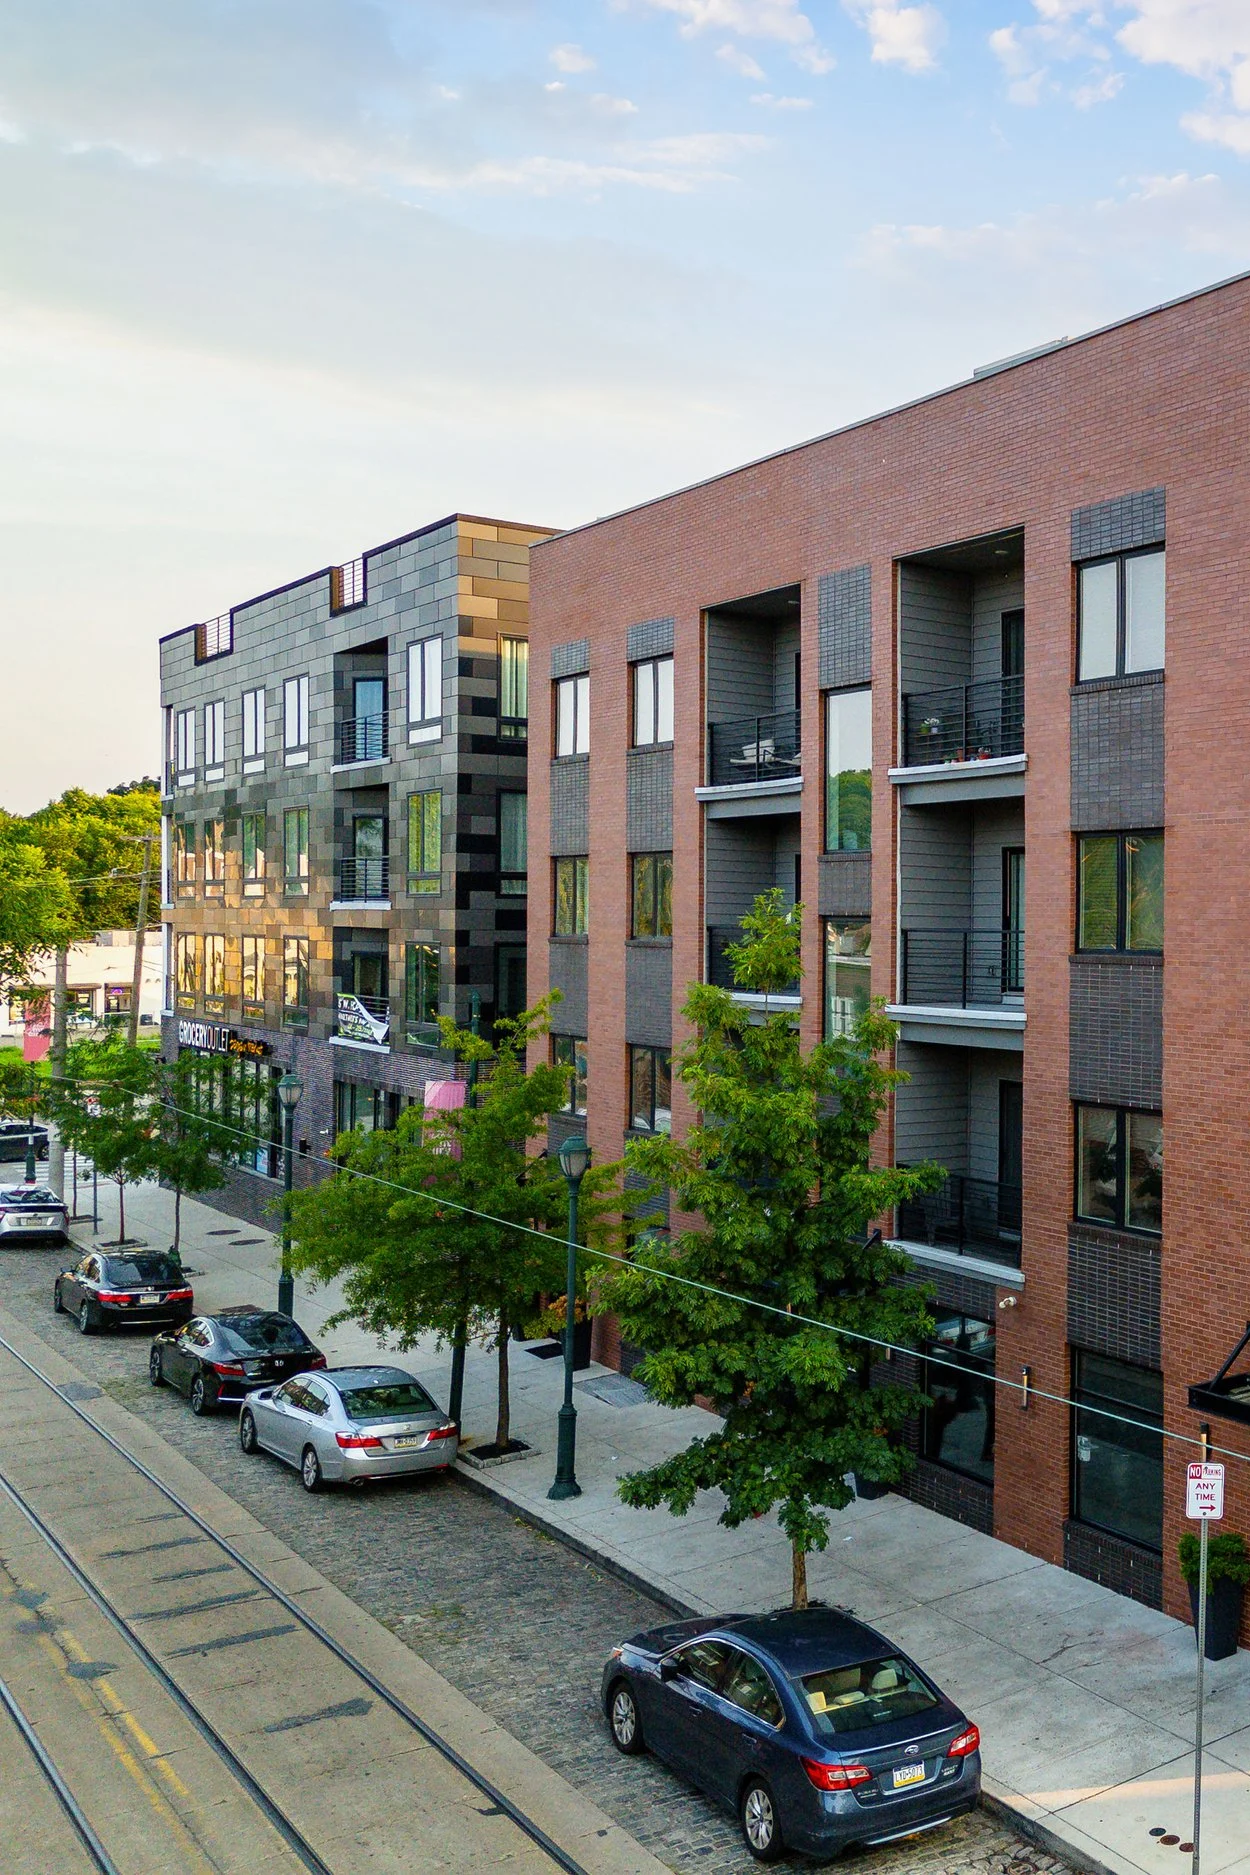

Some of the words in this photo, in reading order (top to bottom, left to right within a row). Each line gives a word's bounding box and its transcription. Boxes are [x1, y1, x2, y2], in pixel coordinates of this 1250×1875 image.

[178, 1020, 207, 1048] GROCERY
[206, 1025, 230, 1052] OUTLET
[1190, 1466, 1201, 1477] NO
[1195, 1482, 1216, 1490] ANY
[1195, 1493, 1216, 1501] TIME
